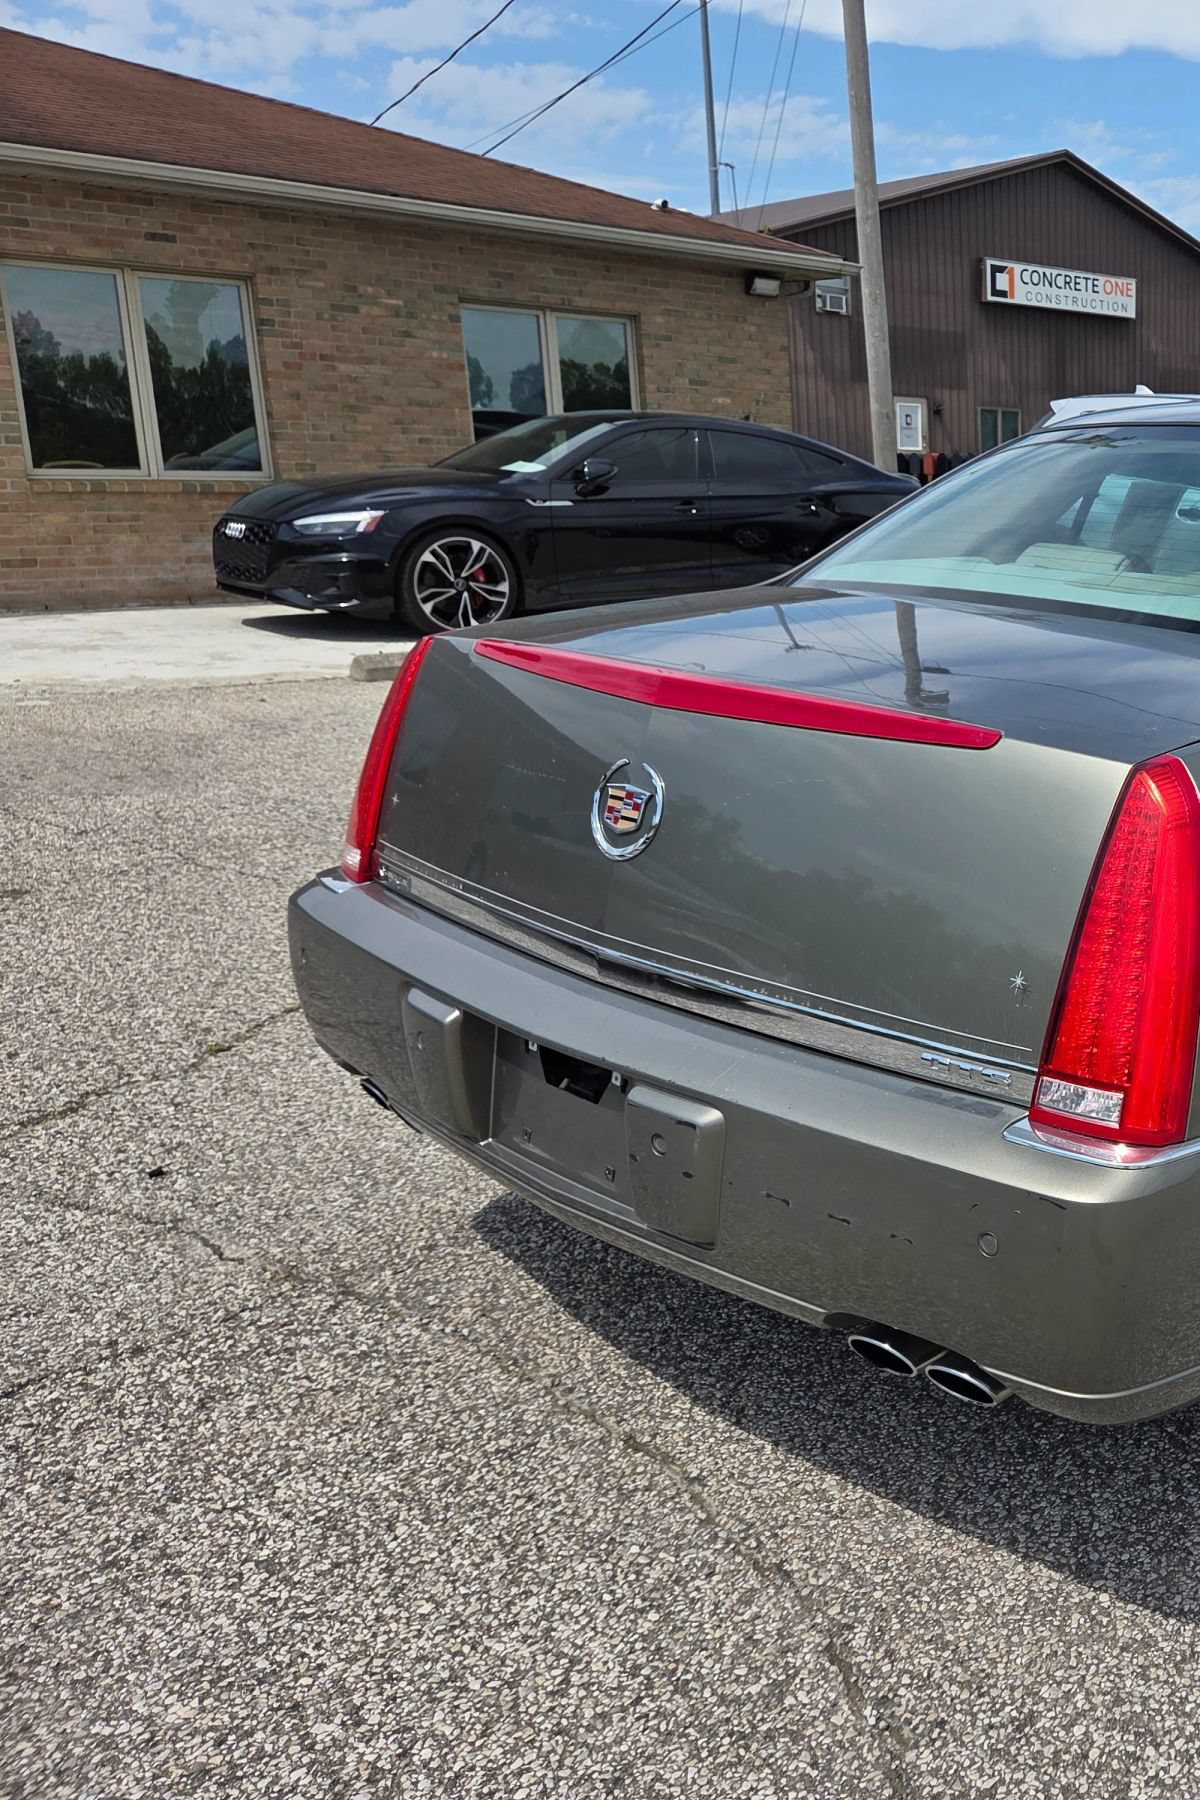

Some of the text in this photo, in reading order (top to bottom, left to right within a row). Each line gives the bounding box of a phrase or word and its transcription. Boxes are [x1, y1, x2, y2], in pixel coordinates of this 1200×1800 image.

[1020, 268, 1133, 298] CONCRETE ONE
[1025, 290, 1128, 313] CONSTRUCTION
